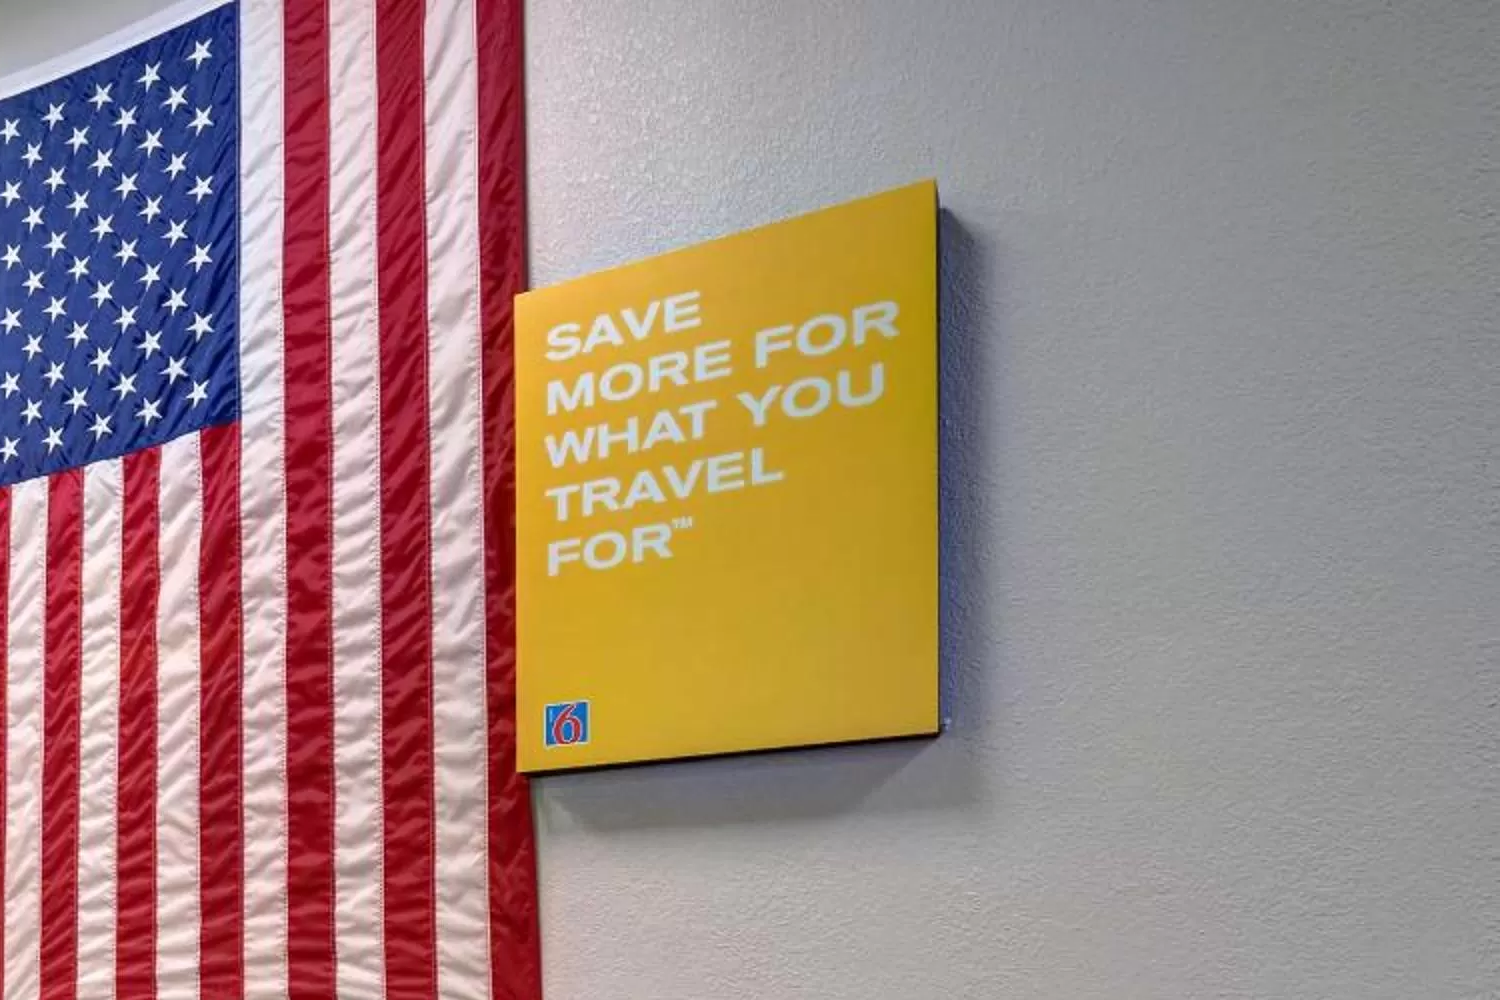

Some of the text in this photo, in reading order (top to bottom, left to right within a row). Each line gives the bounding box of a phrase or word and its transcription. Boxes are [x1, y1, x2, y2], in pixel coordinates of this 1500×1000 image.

[544, 290, 702, 362] SAVE
[546, 300, 900, 417] MORE FOR
[544, 361, 885, 469] WHAT YOU
[544, 447, 786, 522] TRAVEL
[552, 702, 583, 746] 6
